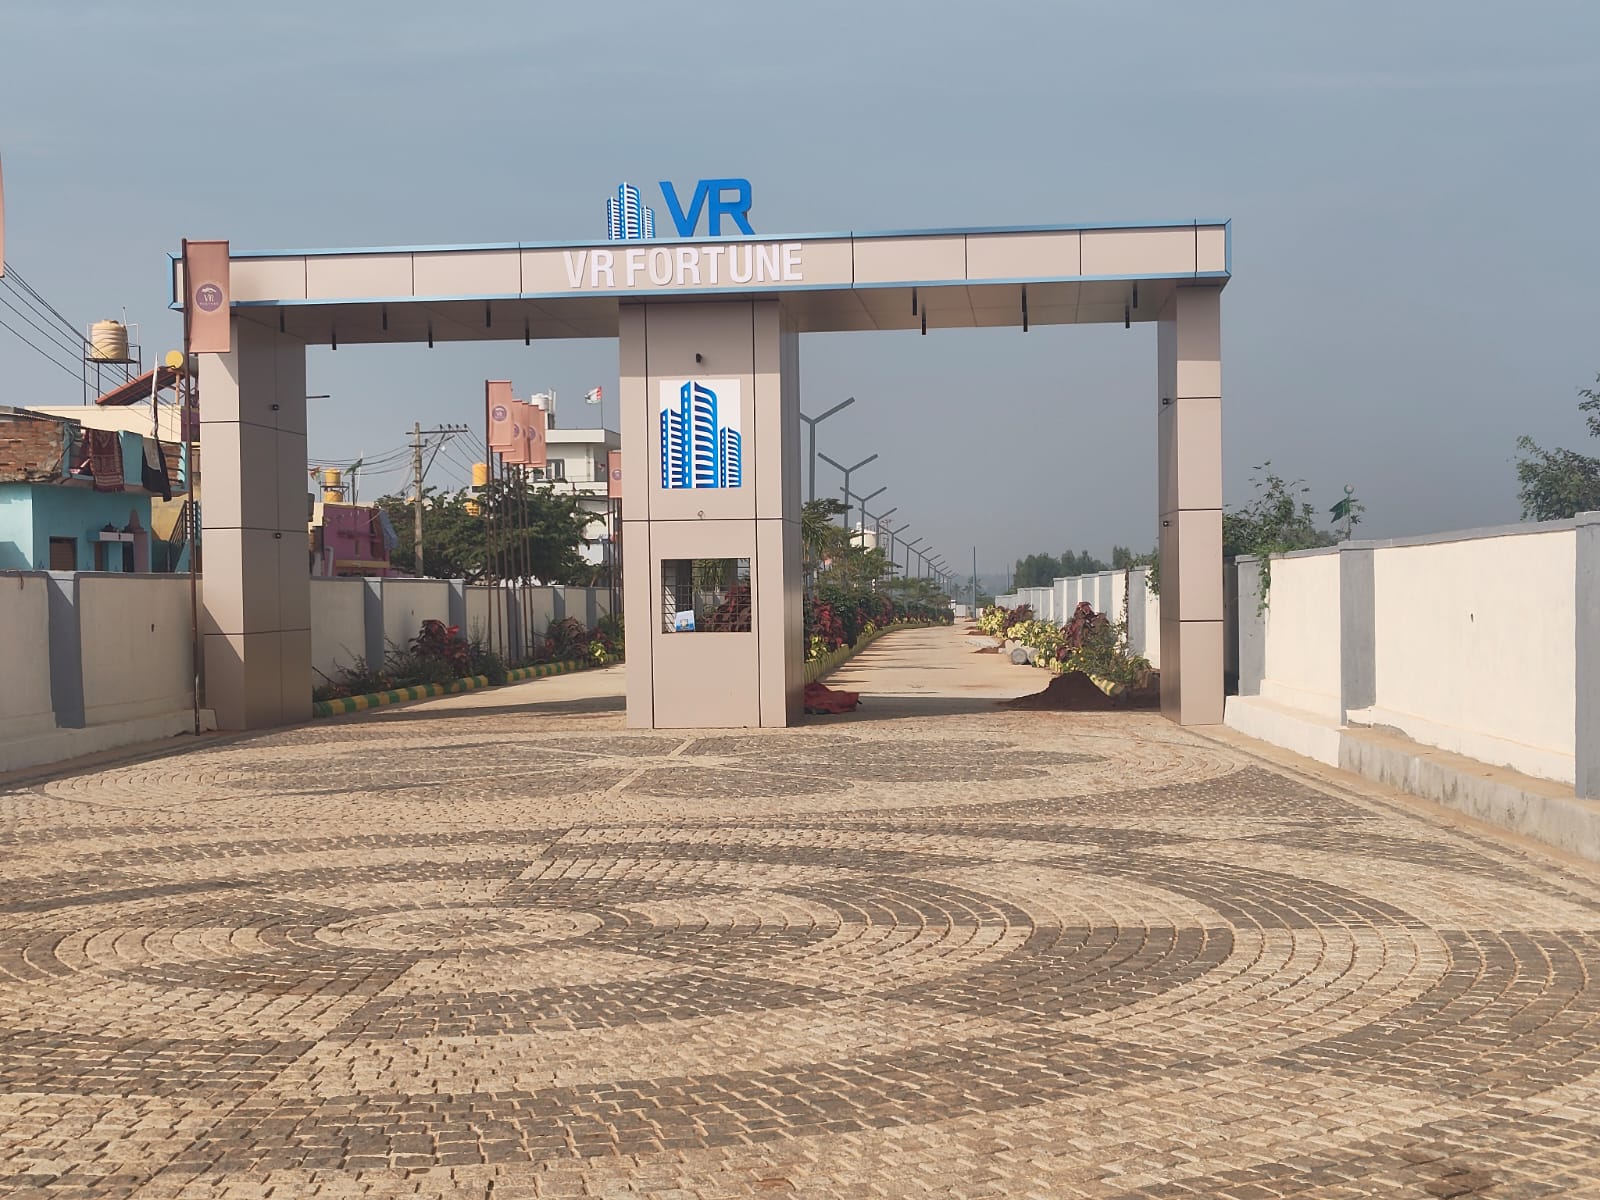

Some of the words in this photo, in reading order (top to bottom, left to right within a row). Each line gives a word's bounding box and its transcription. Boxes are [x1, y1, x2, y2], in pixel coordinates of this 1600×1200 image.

[659, 178, 755, 237] VR
[562, 249, 615, 288] VR
[625, 243, 804, 287] FORTUNE
